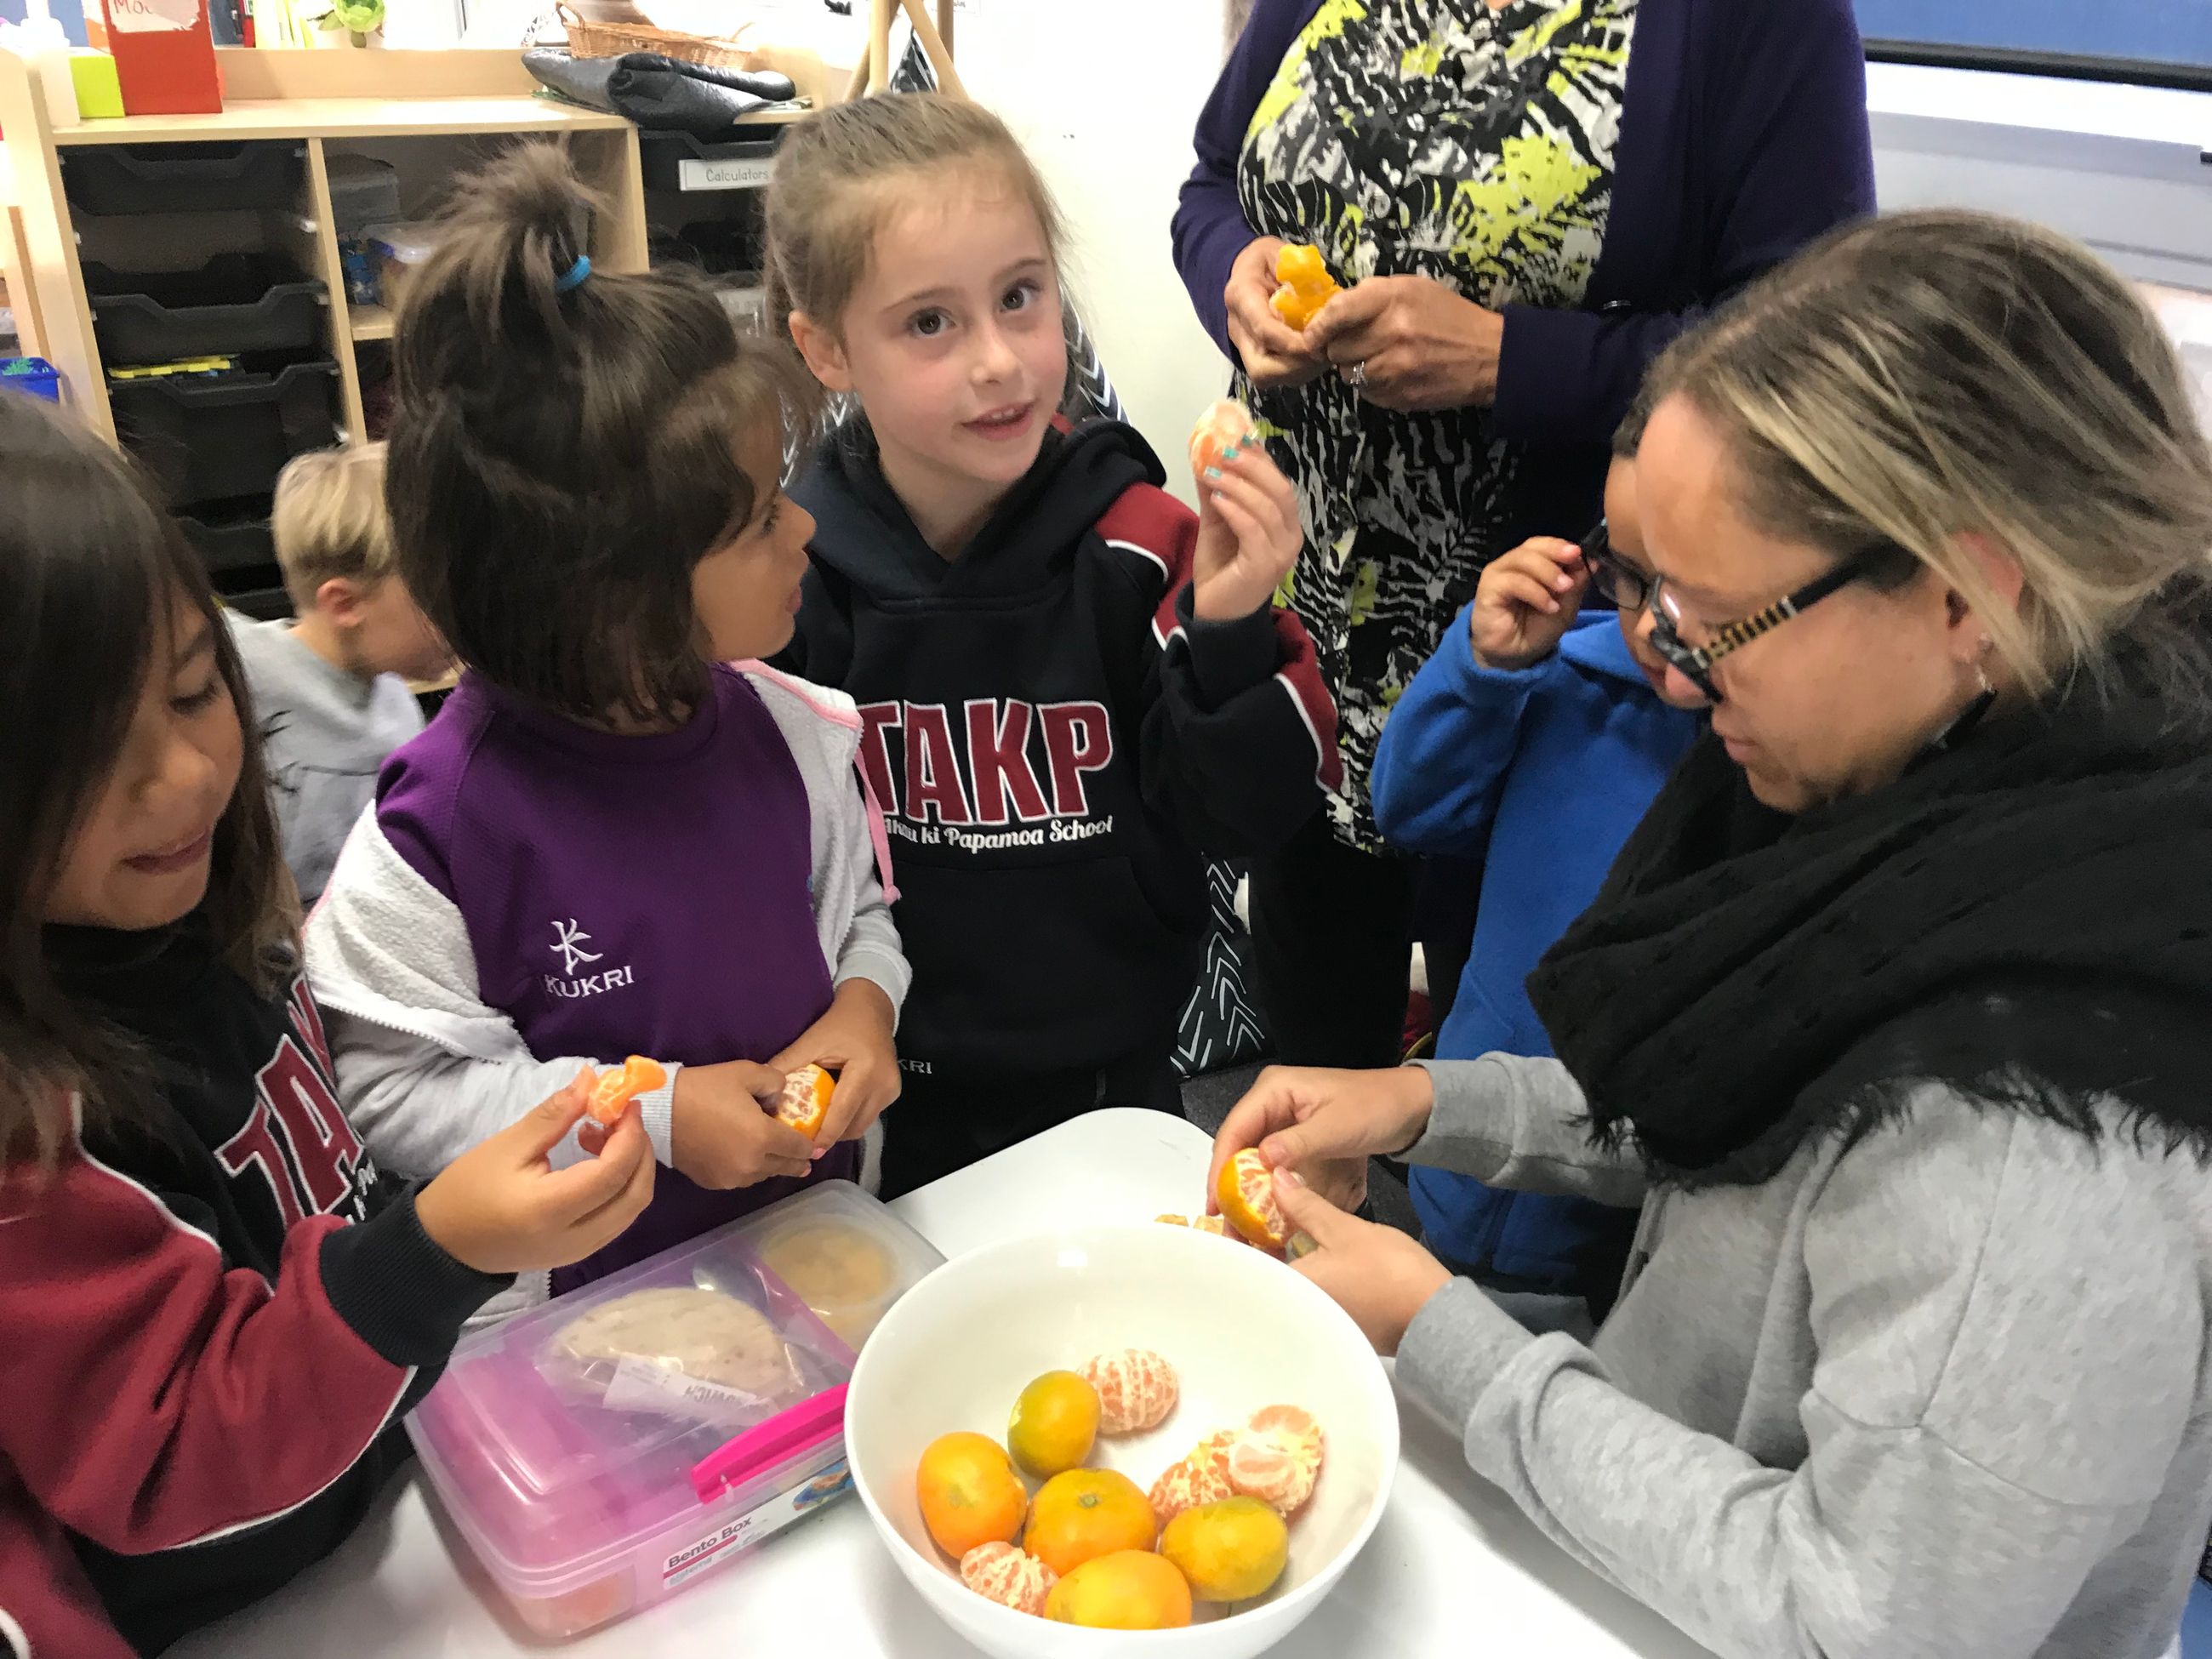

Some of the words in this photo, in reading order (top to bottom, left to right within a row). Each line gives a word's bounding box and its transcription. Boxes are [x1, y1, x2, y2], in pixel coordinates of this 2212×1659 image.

[705, 168, 768, 182] Calculators
[858, 697, 1114, 825] TAKP
[921, 826, 941, 844] ki
[944, 827, 1044, 854] Papamoa
[1050, 815, 1113, 842] School
[544, 965, 635, 998] KUKRI
[898, 1058, 932, 1075] KRI
[668, 1537, 717, 1568] Bento
[721, 1517, 751, 1540] Box
